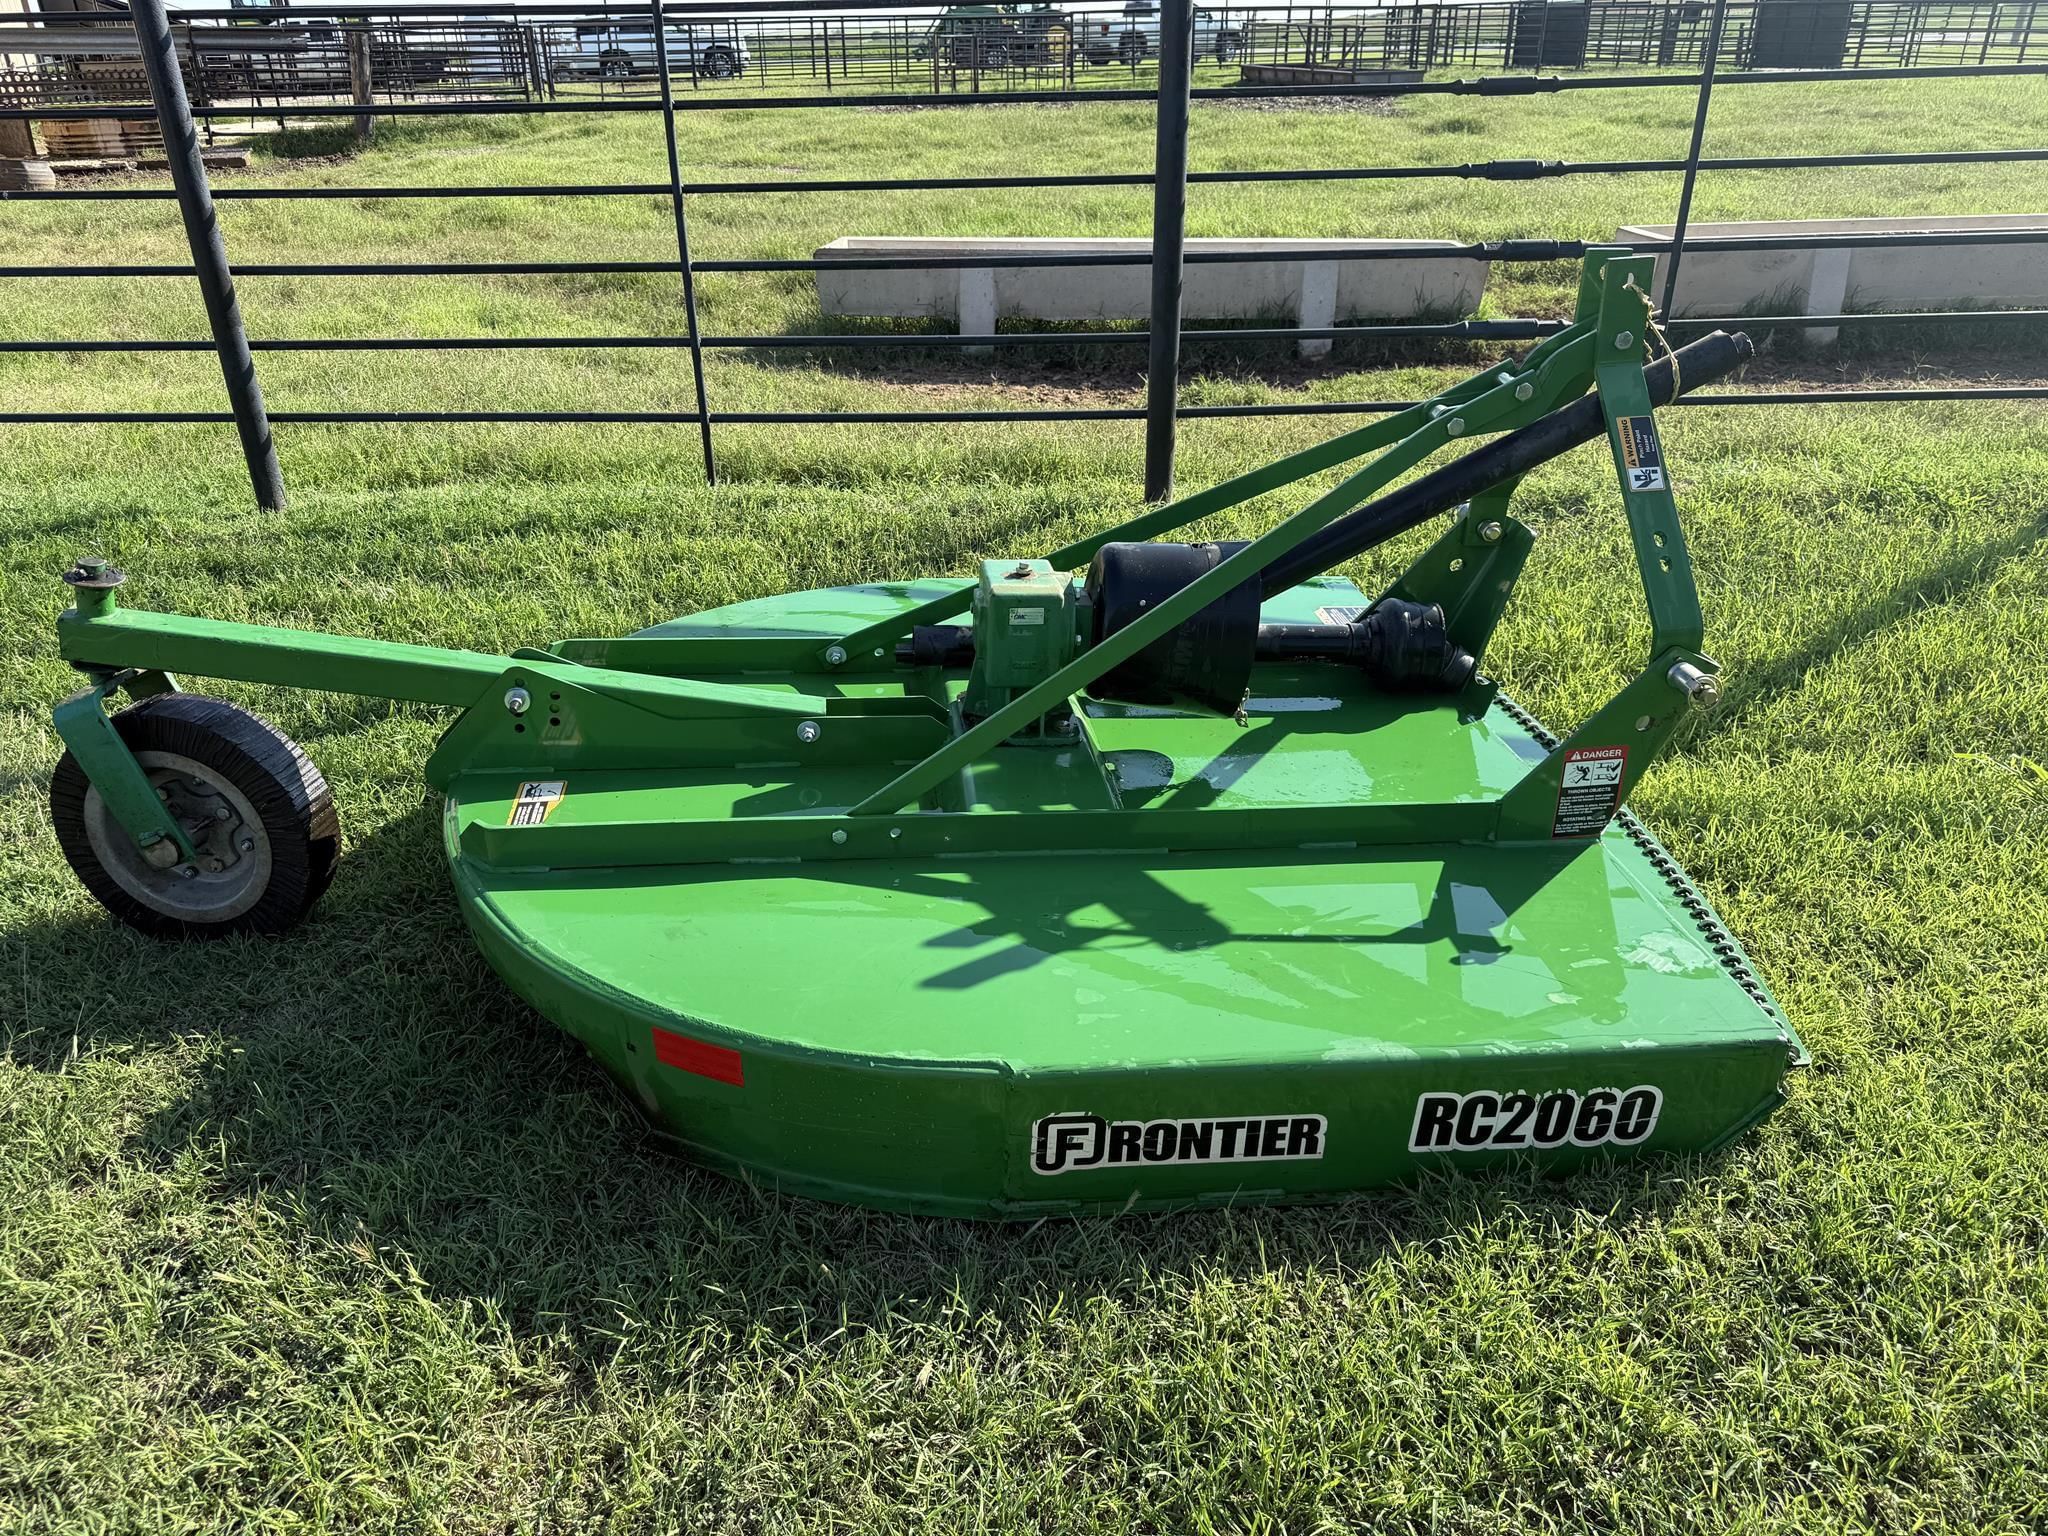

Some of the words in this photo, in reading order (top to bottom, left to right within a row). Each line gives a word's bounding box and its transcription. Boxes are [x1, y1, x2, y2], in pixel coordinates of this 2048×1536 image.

[1621, 419, 1633, 458] WARNING
[1582, 749, 1622, 759] DANGER
[1414, 1090, 1657, 1147] RC2060
[1036, 1114, 1322, 1173] FRONTIER
